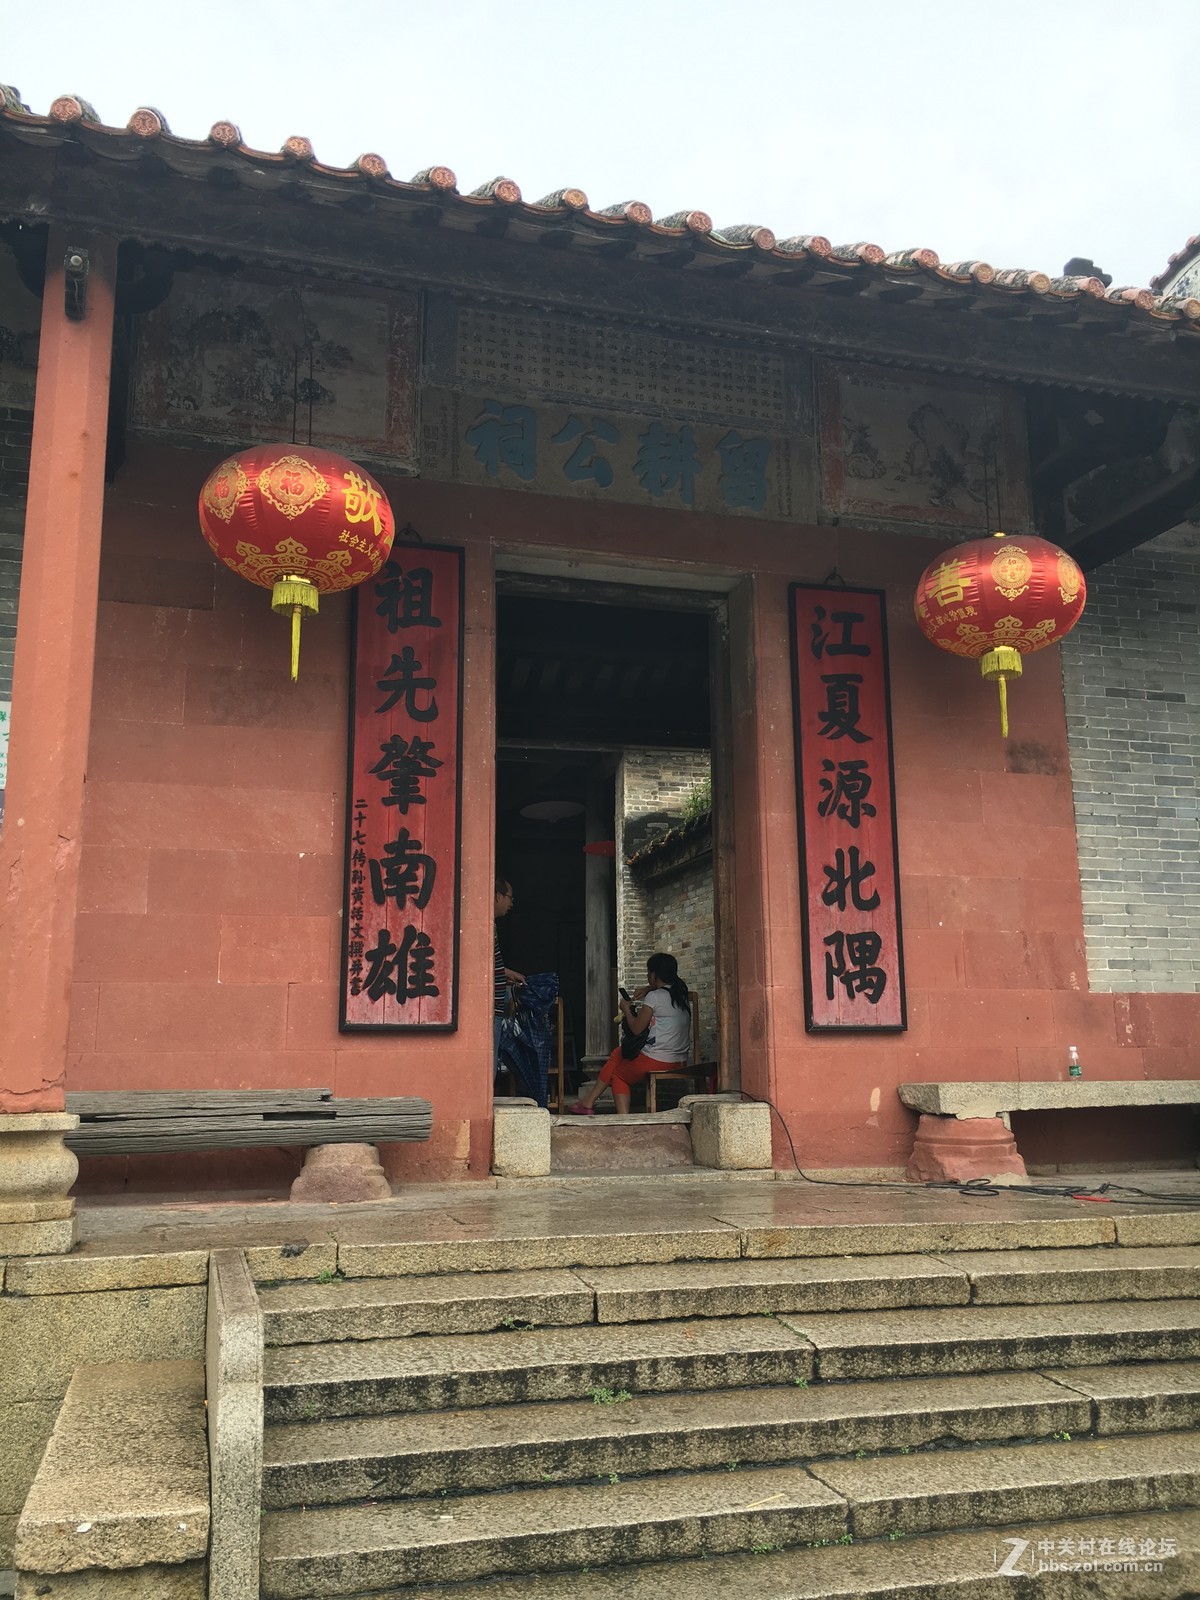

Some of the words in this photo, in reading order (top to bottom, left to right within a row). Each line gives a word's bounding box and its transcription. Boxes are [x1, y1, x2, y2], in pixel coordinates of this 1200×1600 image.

[280, 470, 305, 496] 福
[341, 470, 382, 536] 敬
[363, 562, 444, 1004] 祖先肇南雄
[810, 606, 887, 1003] 江夏源北隅
